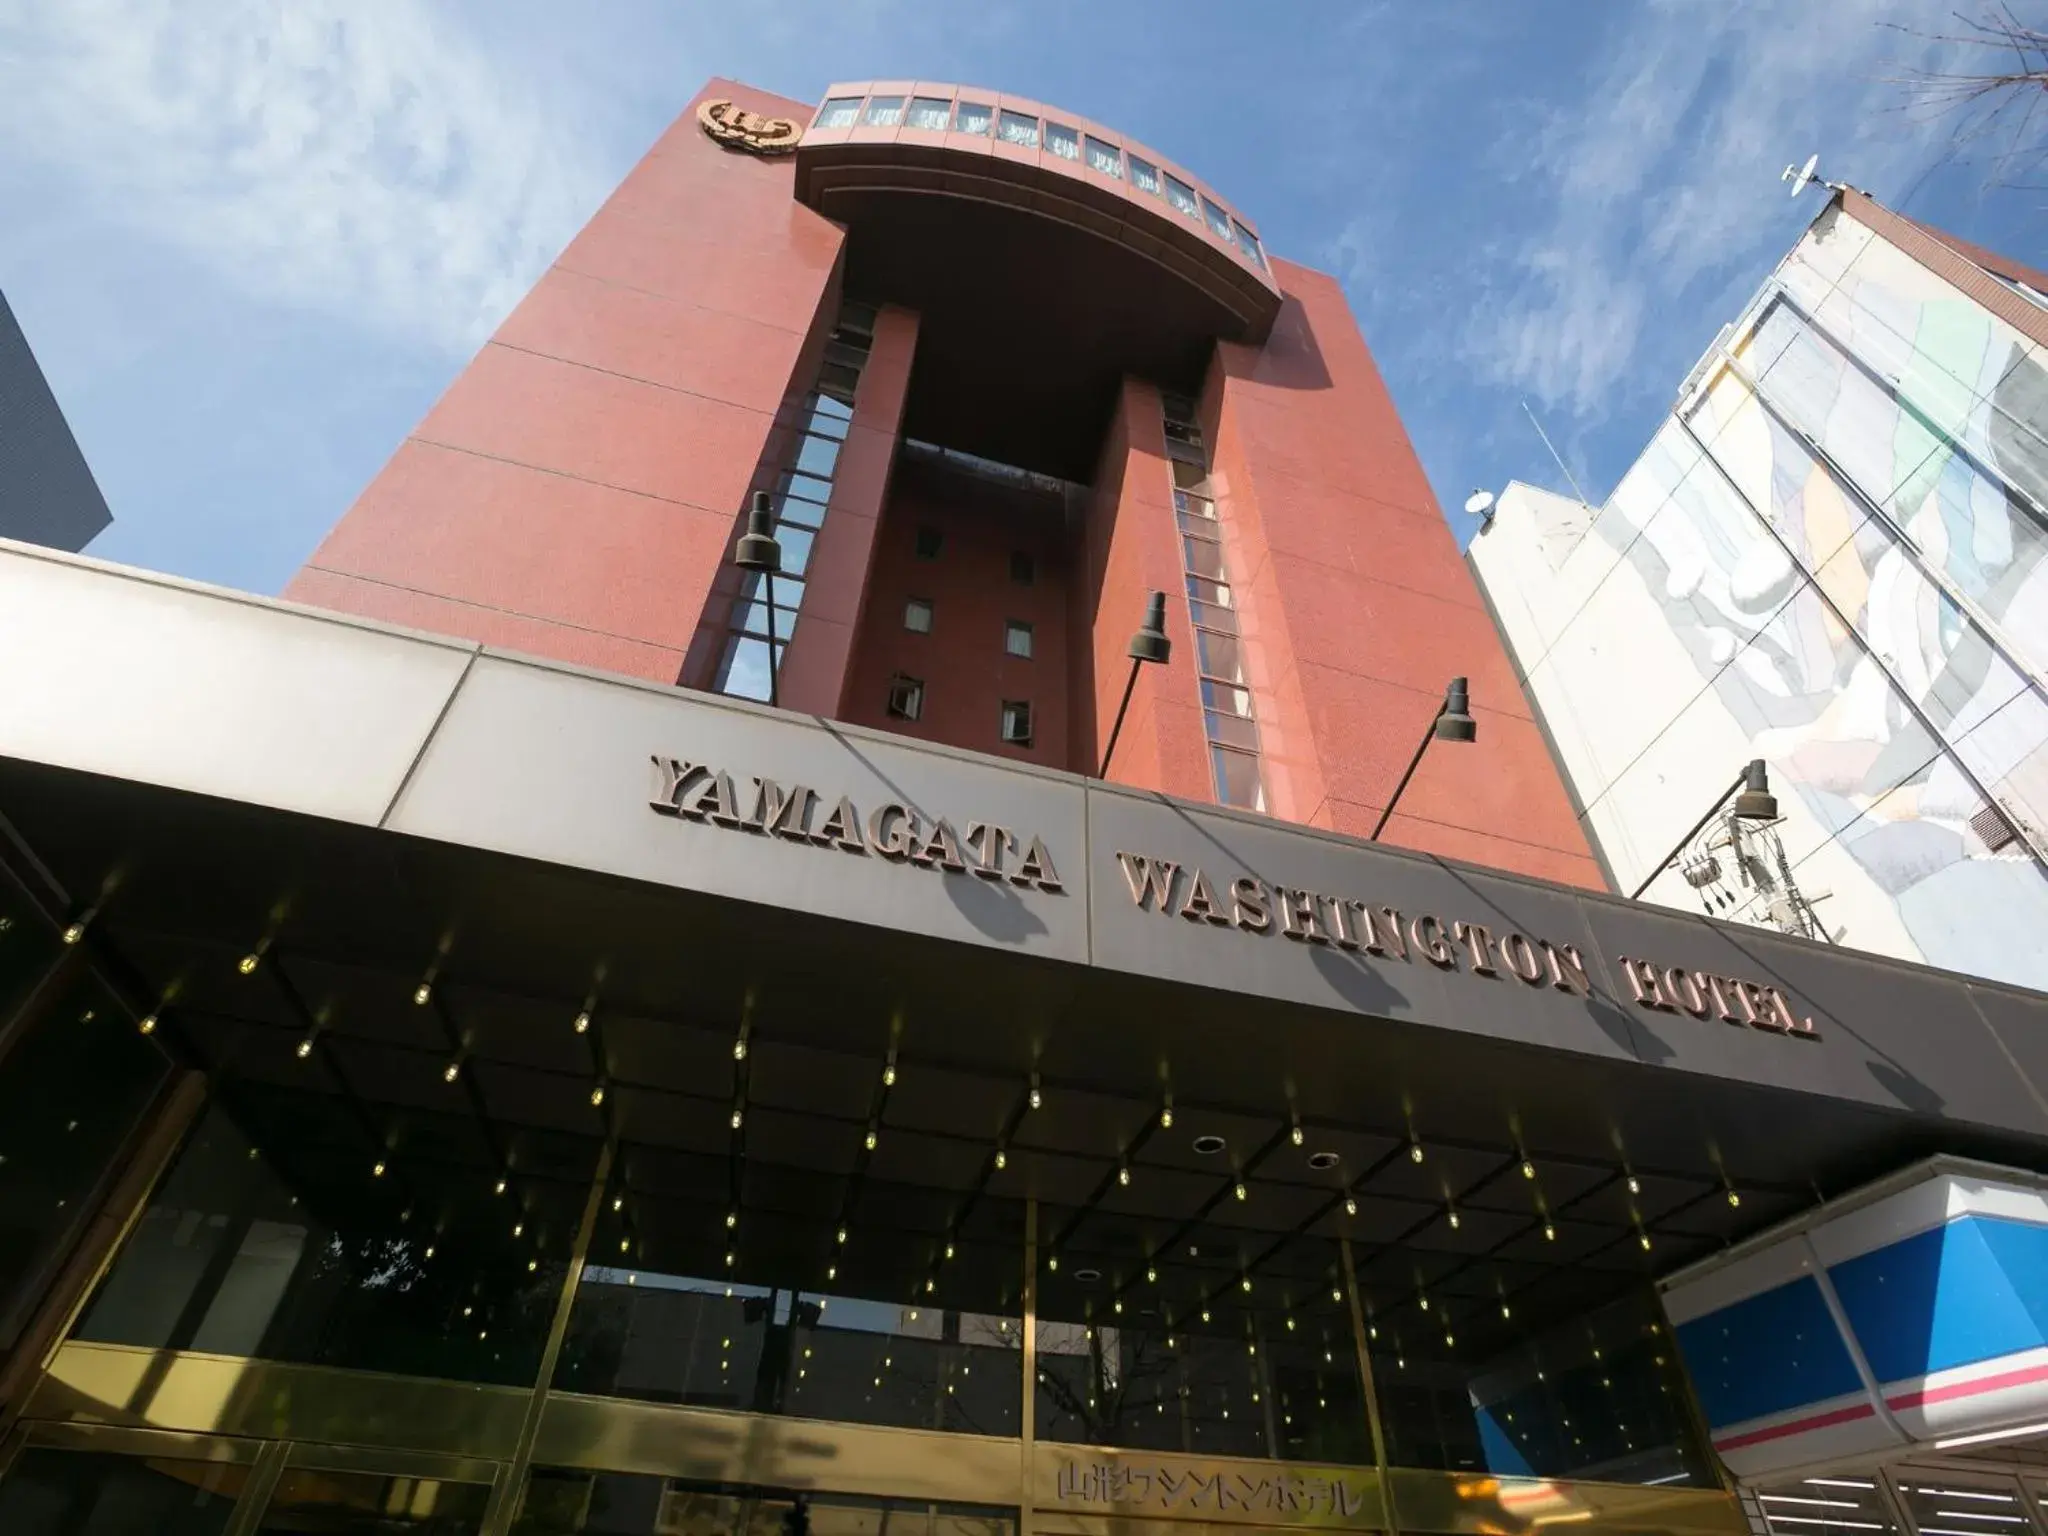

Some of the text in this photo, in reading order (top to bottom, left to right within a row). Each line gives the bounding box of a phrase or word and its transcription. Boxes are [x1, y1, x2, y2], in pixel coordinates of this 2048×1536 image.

[650, 755, 1820, 1040] YAMAGATA WASHINGTON HOTEL
[1057, 1460, 1365, 1517] 山形ワシントンホテル
